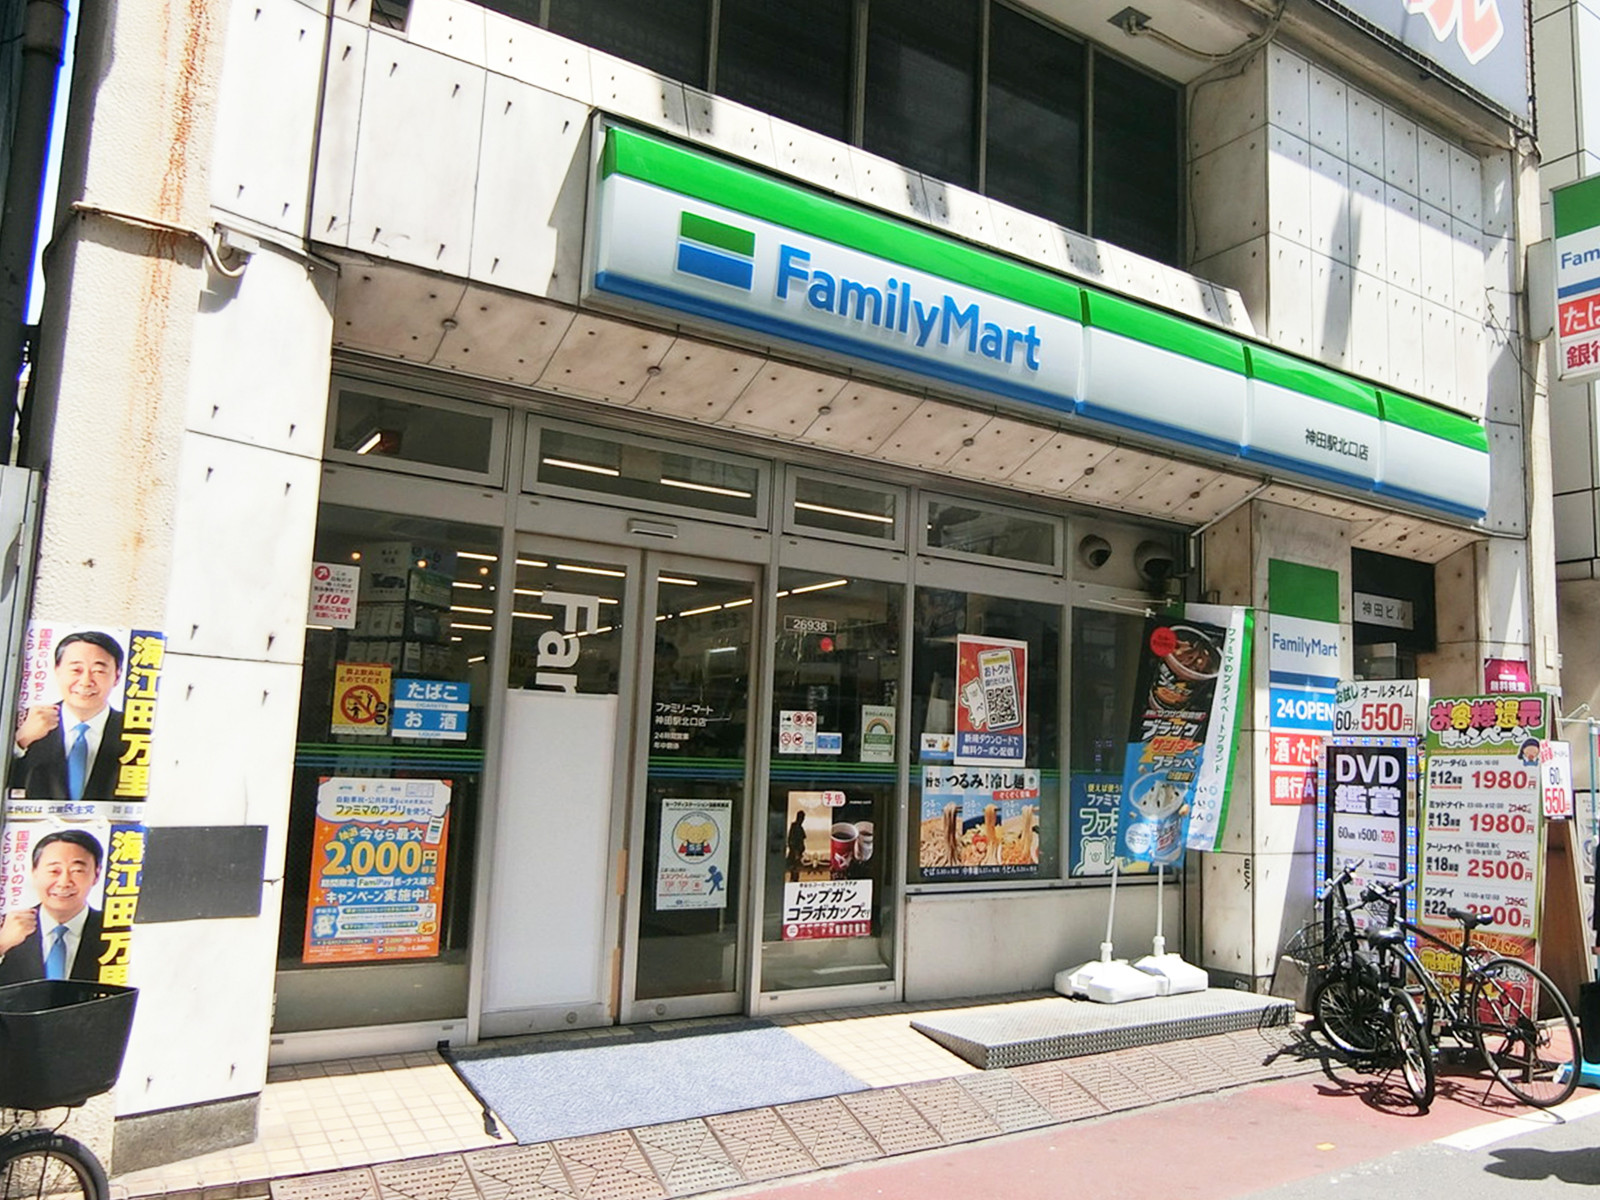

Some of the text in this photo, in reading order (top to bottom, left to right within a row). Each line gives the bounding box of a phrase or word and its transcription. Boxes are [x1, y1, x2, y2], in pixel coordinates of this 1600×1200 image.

[776, 244, 1041, 371] FamilyMart
[1305, 428, 1369, 461] 神田駅北口店
[1362, 601, 1406, 620] 神田ビル
[793, 619, 828, 632] 26938
[1272, 633, 1338, 658] FamilyMart
[407, 682, 458, 700] たばこ
[1361, 684, 1413, 698] オールタイム
[114, 635, 166, 797] 海江田万里
[655, 702, 714, 715] ファミリーマート
[1335, 703, 1413, 731] 60分 550円
[1429, 700, 1543, 732] お客様還元
[655, 715, 706, 727] 神田駅北口店
[1141, 719, 1200, 740] ブラック
[1151, 738, 1202, 753] サンダー
[1440, 727, 1529, 746] キャンペーン
[1335, 754, 1400, 785] DVD
[1431, 759, 1468, 767] フリータイム
[1471, 769, 1537, 790] 1980円
[335, 803, 433, 816] ファミマのアプリを使うと
[1335, 784, 1400, 816] 鑑賞
[1429, 800, 1465, 809] ミッドナイト
[1469, 813, 1535, 834] 1980円
[360, 826, 423, 841] 今なら最大
[1467, 858, 1533, 881] 2500円
[326, 887, 431, 904] キャンペーン実施中！
[795, 888, 858, 905] トップガン
[1424, 886, 1455, 898] ワンデイ
[786, 902, 870, 921] コラボカップで！
